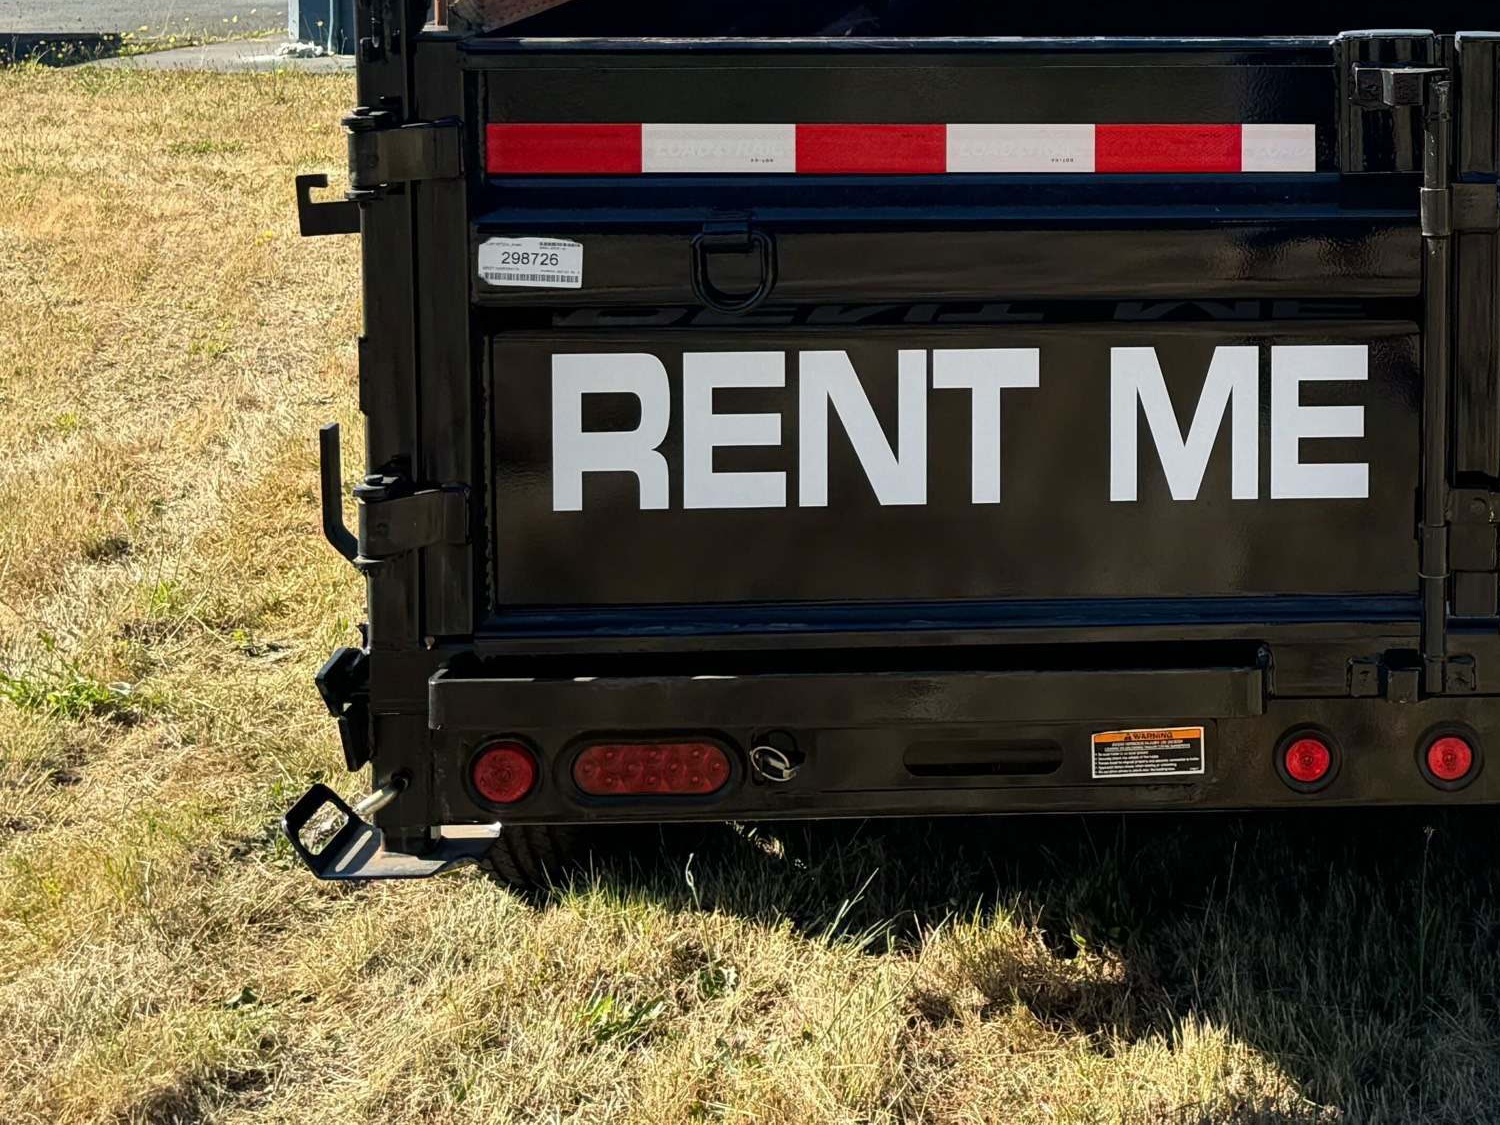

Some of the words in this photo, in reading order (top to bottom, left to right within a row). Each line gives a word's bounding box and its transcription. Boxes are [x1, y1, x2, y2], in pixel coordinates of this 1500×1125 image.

[501, 251, 559, 266] 298726
[551, 347, 1040, 512] RENT
[1109, 344, 1369, 502] ME
[1132, 731, 1173, 740] WARNING
